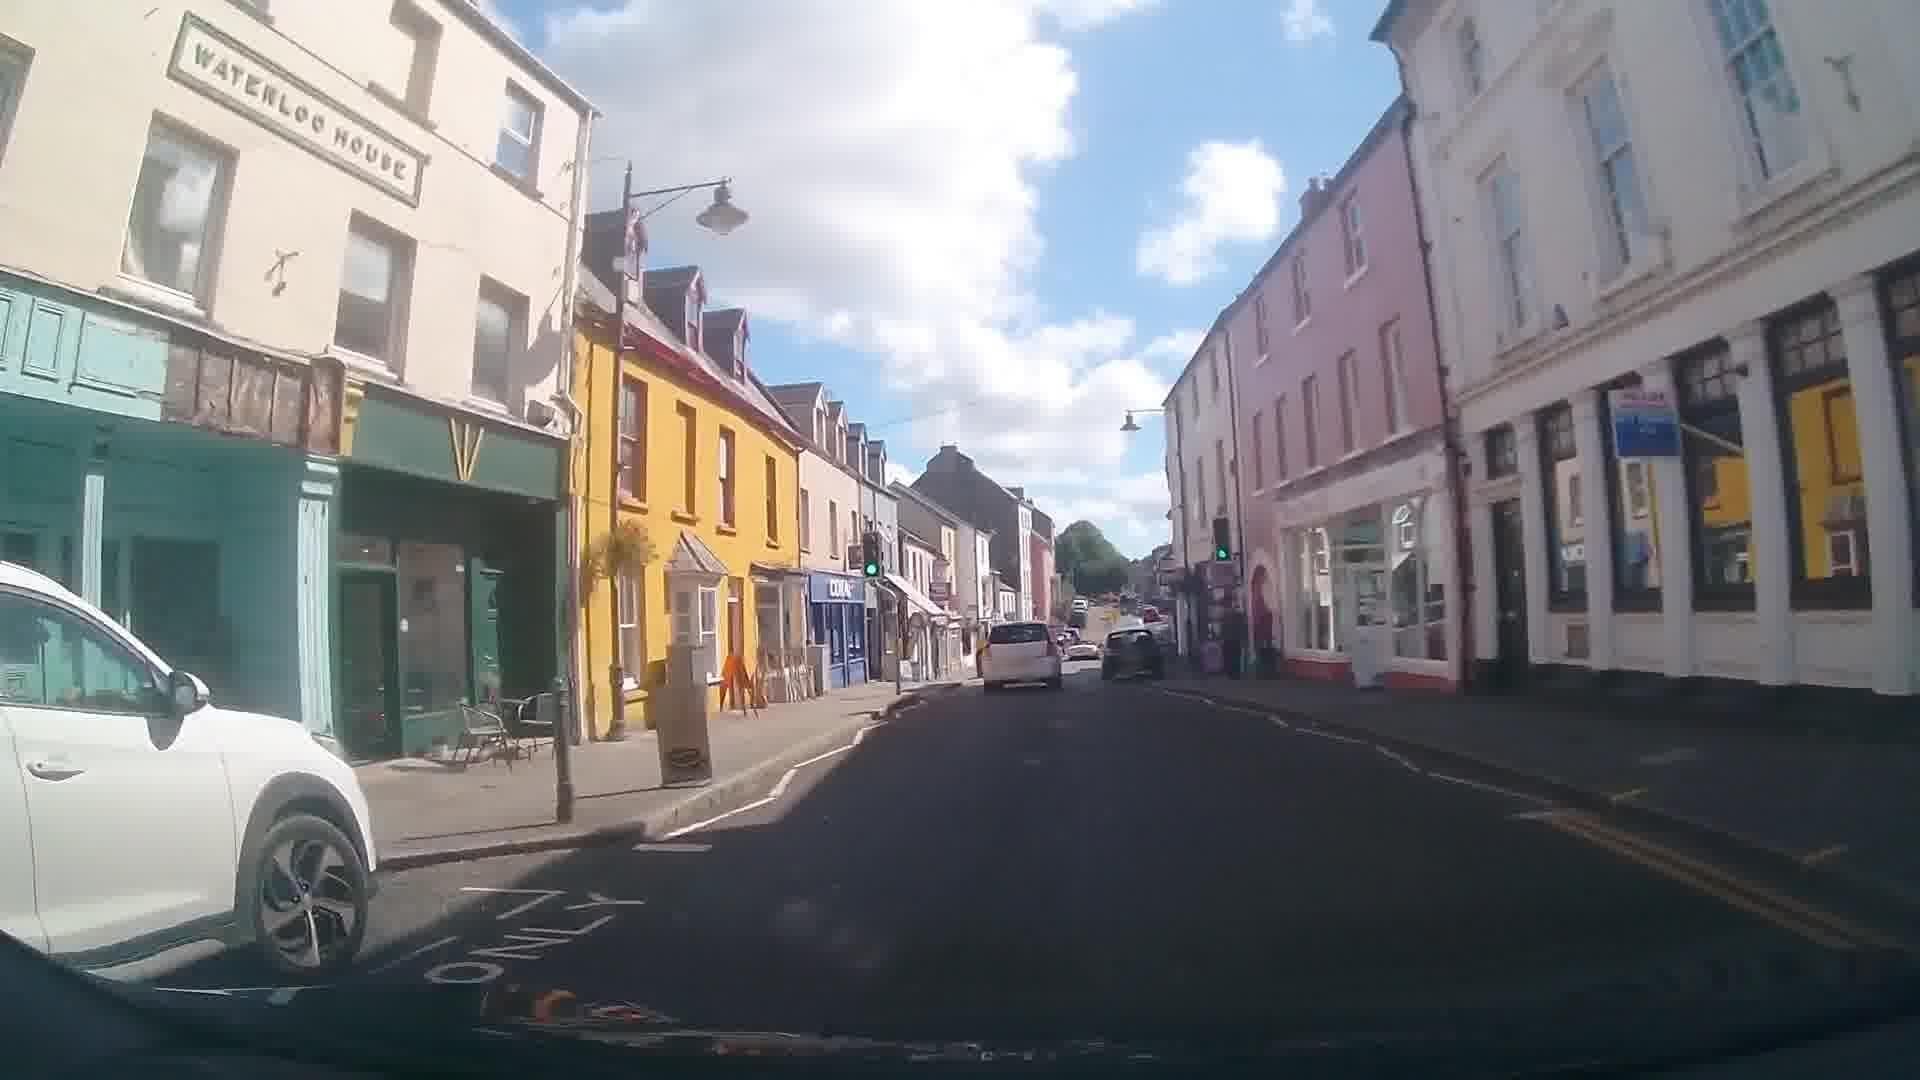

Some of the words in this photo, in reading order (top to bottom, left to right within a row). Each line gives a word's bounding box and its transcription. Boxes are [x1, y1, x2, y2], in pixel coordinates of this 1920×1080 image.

[193, 42, 326, 133] WATERLOO
[332, 127, 409, 181] HOUSE
[423, 889, 647, 985] ONLY
